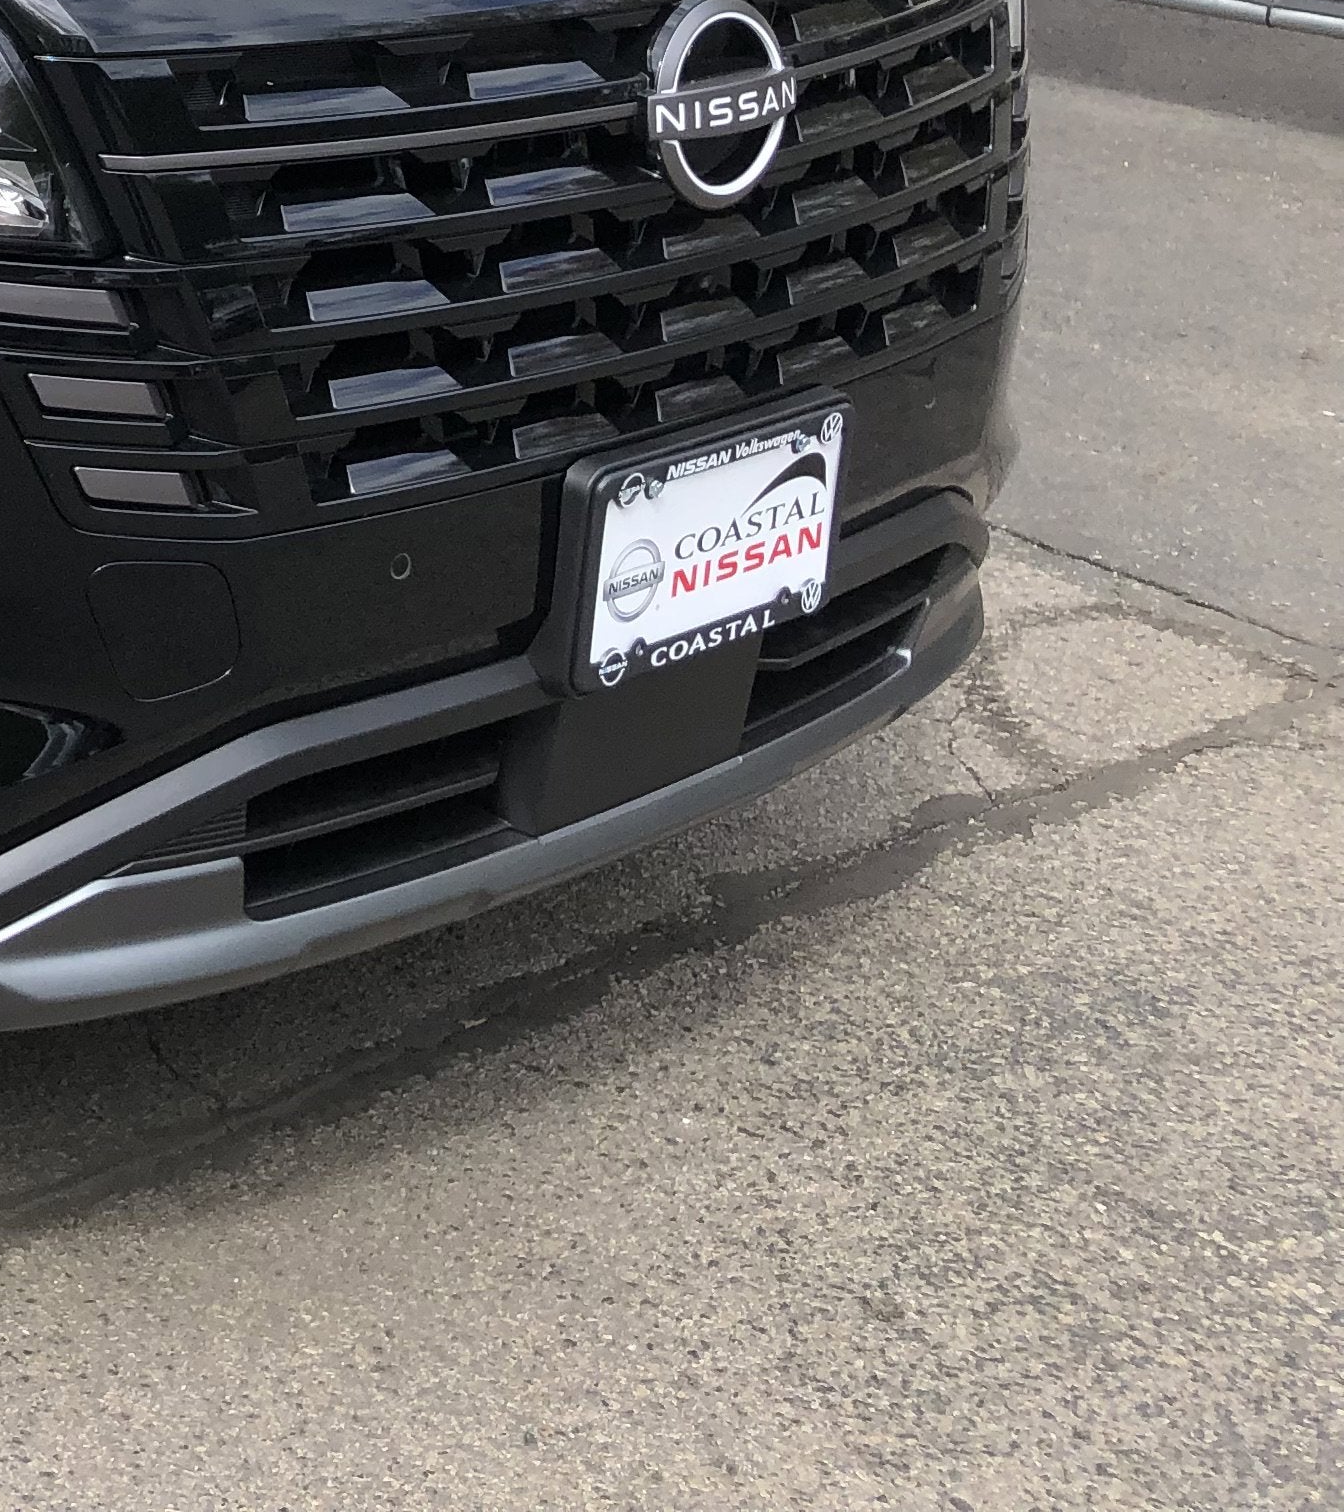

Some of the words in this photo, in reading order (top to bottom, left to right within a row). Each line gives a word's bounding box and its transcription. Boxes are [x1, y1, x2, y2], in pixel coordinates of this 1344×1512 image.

[655, 76, 796, 133] NISSAN
[666, 448, 732, 481] NISSAN
[735, 429, 801, 461] Volkswagen
[674, 490, 825, 560] COASTAL
[609, 568, 659, 595] NISSAN
[671, 521, 823, 598] NISSAN
[650, 608, 776, 667] COASTAL
